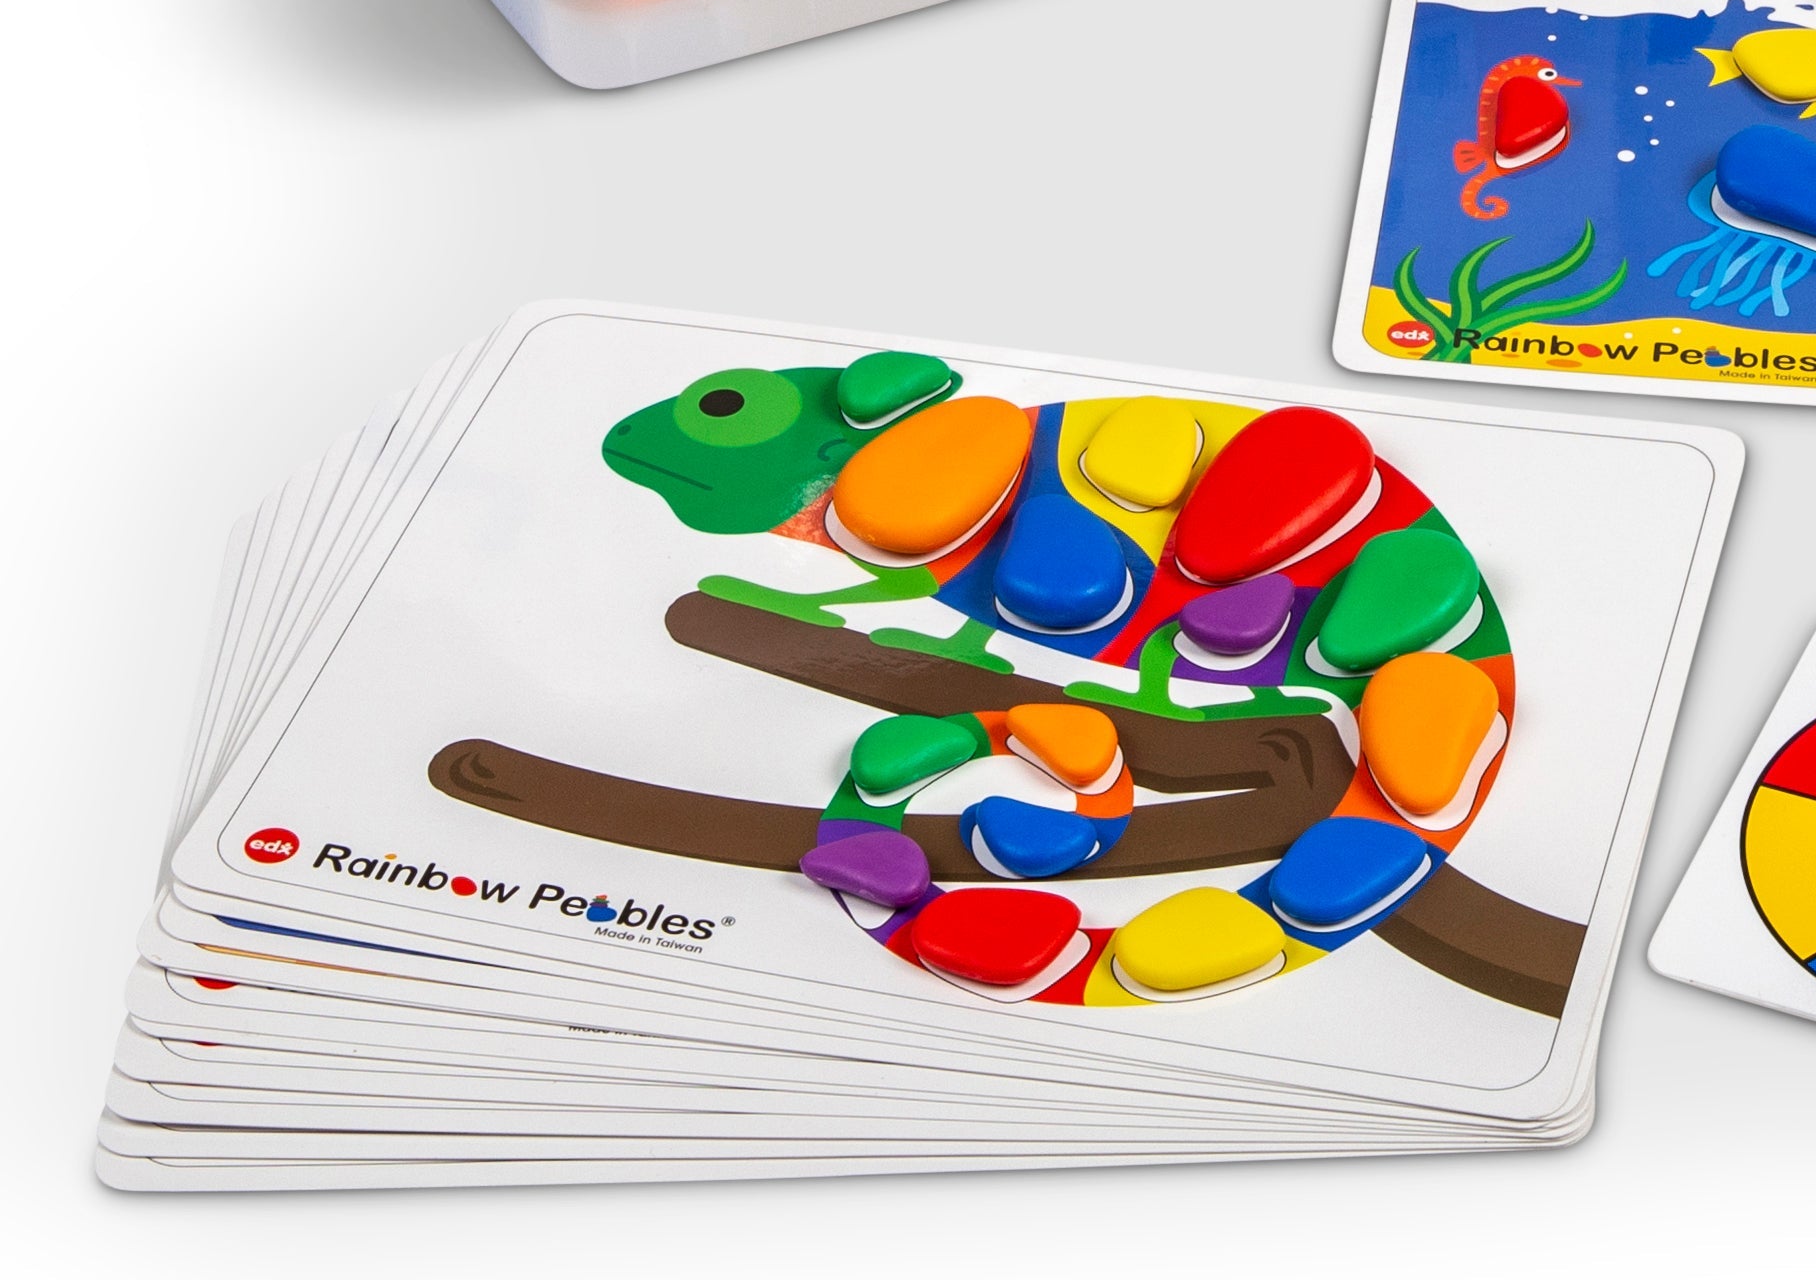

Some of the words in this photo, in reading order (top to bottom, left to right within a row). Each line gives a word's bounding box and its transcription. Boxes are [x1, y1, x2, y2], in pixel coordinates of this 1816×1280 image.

[1390, 327, 1430, 342] edx
[1452, 327, 1639, 360] Rainbow
[1719, 369, 1755, 380] Made
[1760, 372, 1771, 381] in
[248, 838, 294, 856] edx
[312, 842, 520, 904] Rainbow
[594, 927, 636, 941] Made
[639, 933, 651, 944] in
[655, 937, 703, 954] Taiwan
